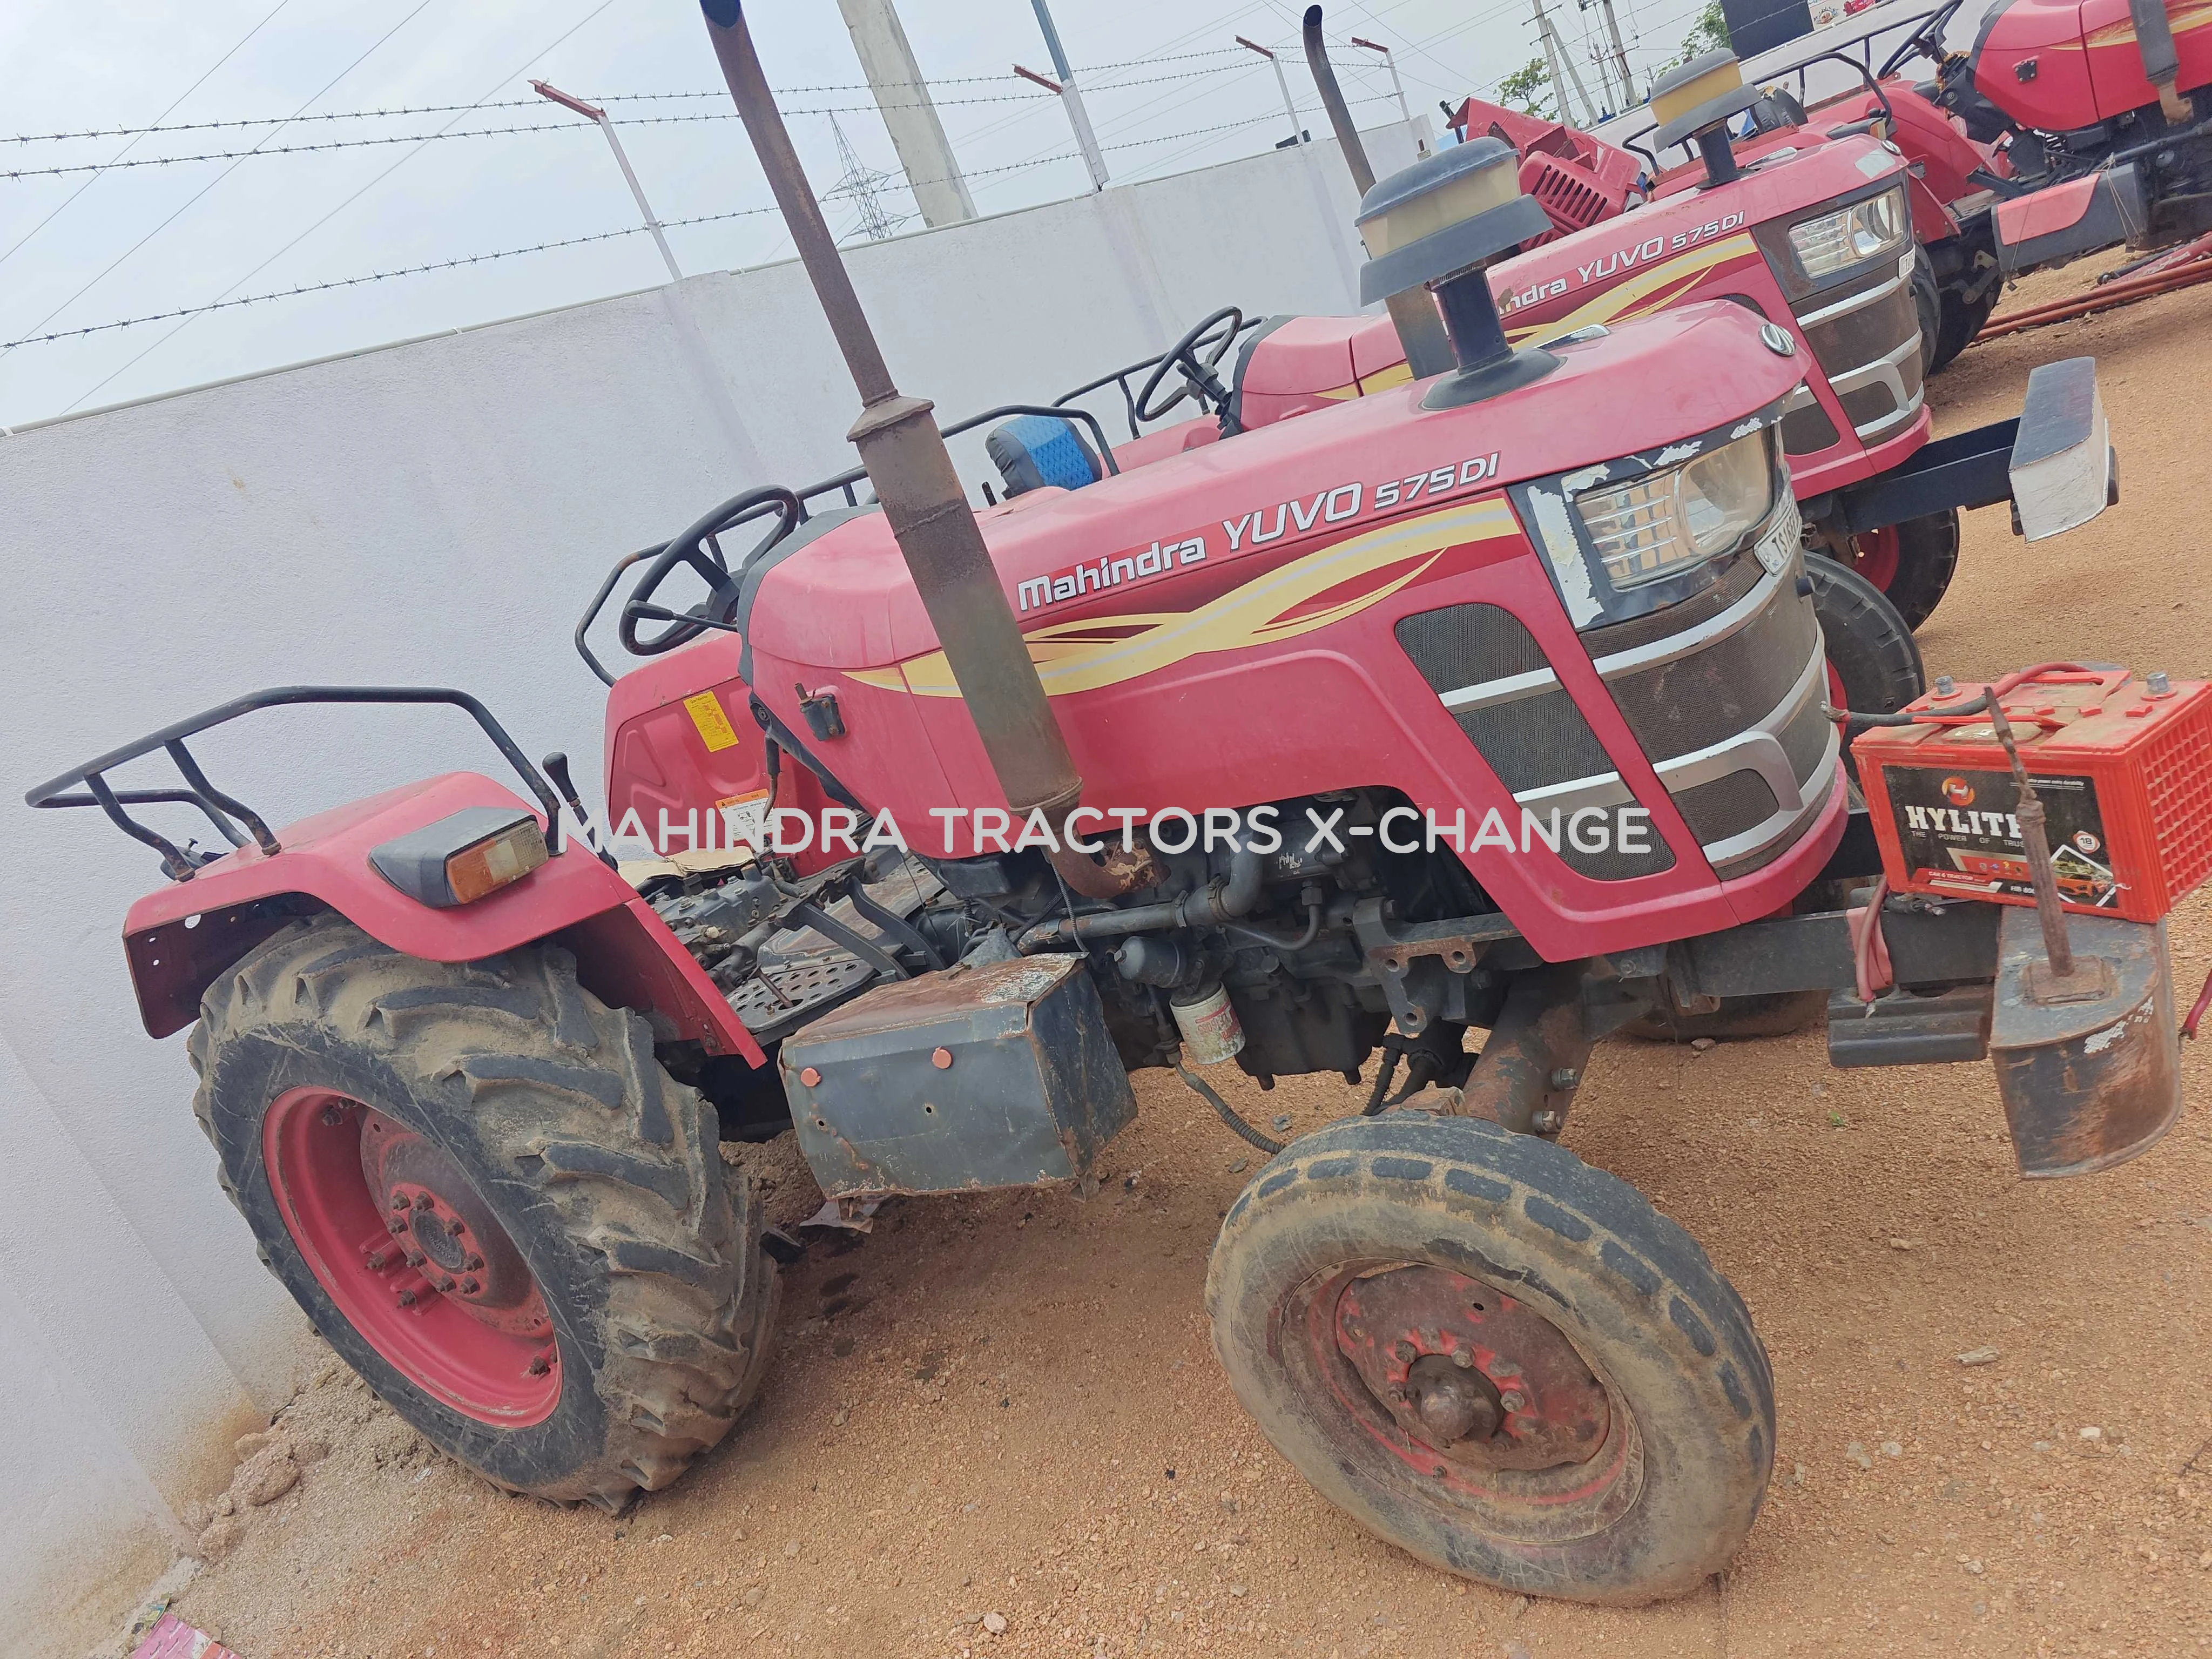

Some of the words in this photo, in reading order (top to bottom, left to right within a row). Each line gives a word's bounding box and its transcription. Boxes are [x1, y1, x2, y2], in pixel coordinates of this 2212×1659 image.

[1577, 235, 1664, 284] YUVO
[1671, 210, 1744, 251] 575DI
[1017, 536, 1206, 611] Mahindra
[1222, 482, 1362, 551] YUVO
[1373, 452, 1499, 509] 575DI
[1938, 833, 1967, 842] POWER
[2002, 839, 2025, 847] TRUS
